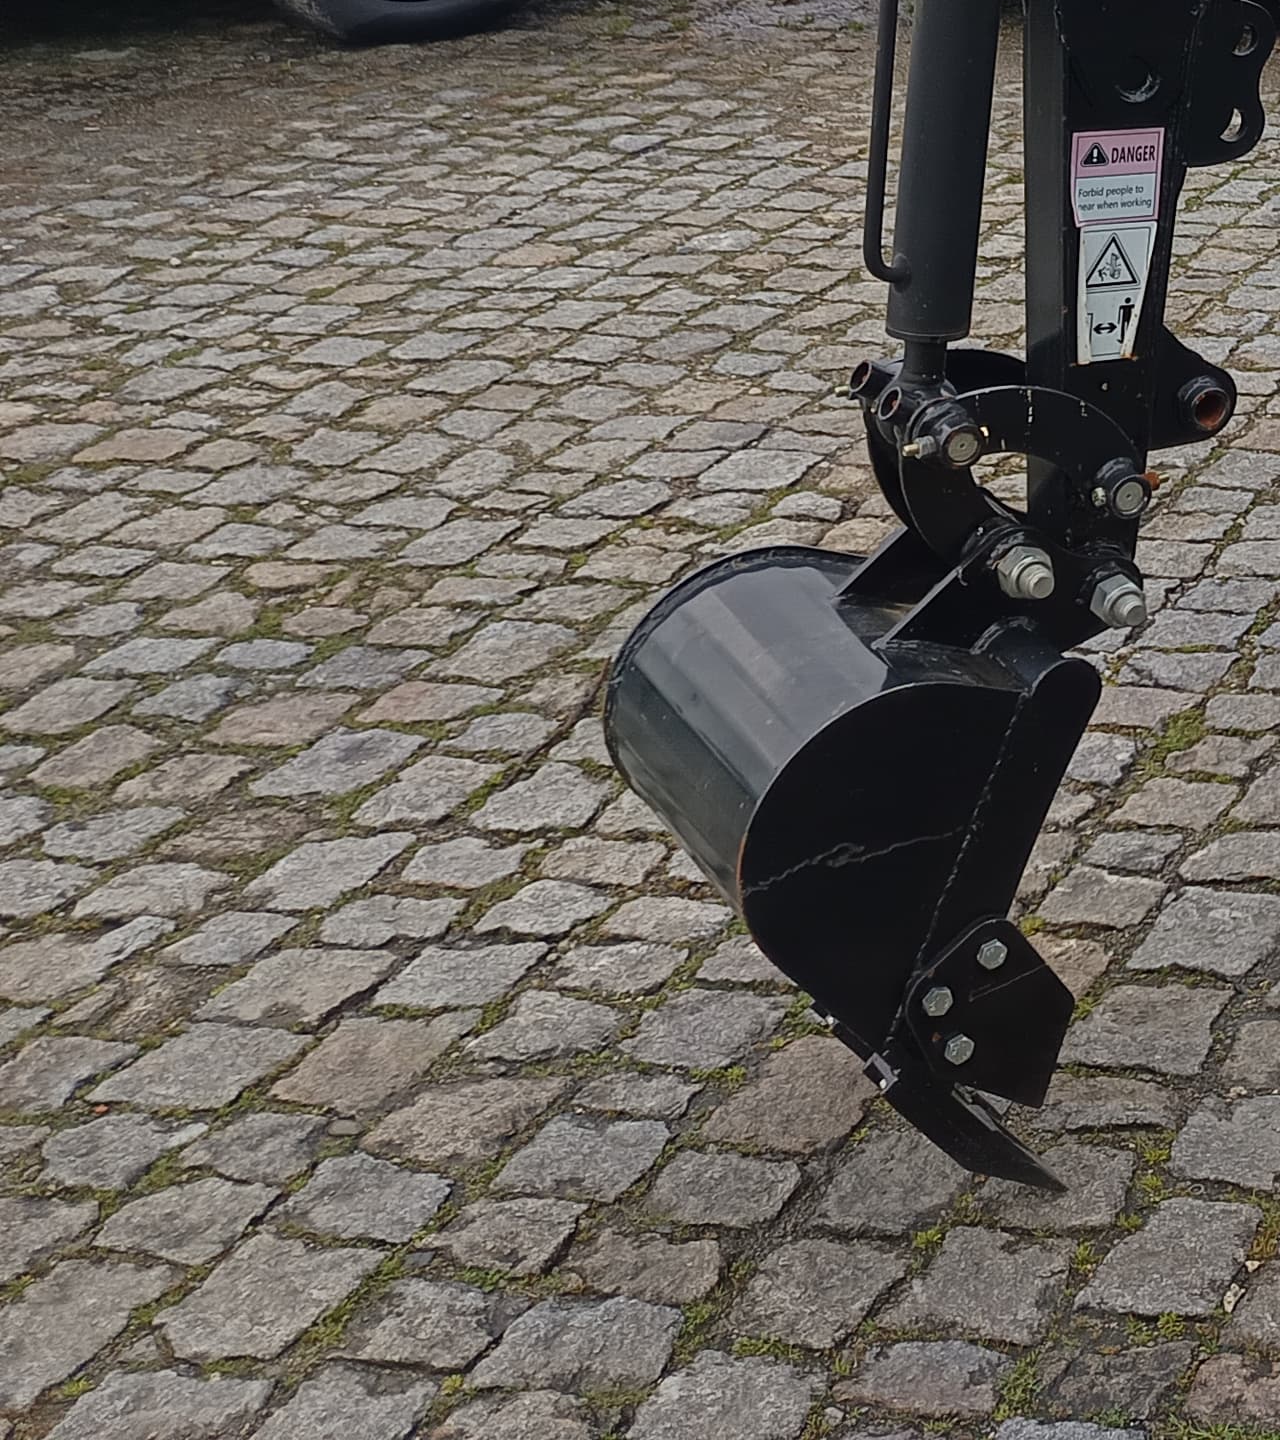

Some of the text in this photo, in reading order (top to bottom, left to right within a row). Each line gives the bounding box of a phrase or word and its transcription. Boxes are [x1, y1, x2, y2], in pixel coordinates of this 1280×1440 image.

[1111, 145, 1156, 164] DANGER
[1078, 185, 1144, 198] Forbid people to
[1096, 200, 1119, 210] when
[1121, 198, 1152, 209] working
